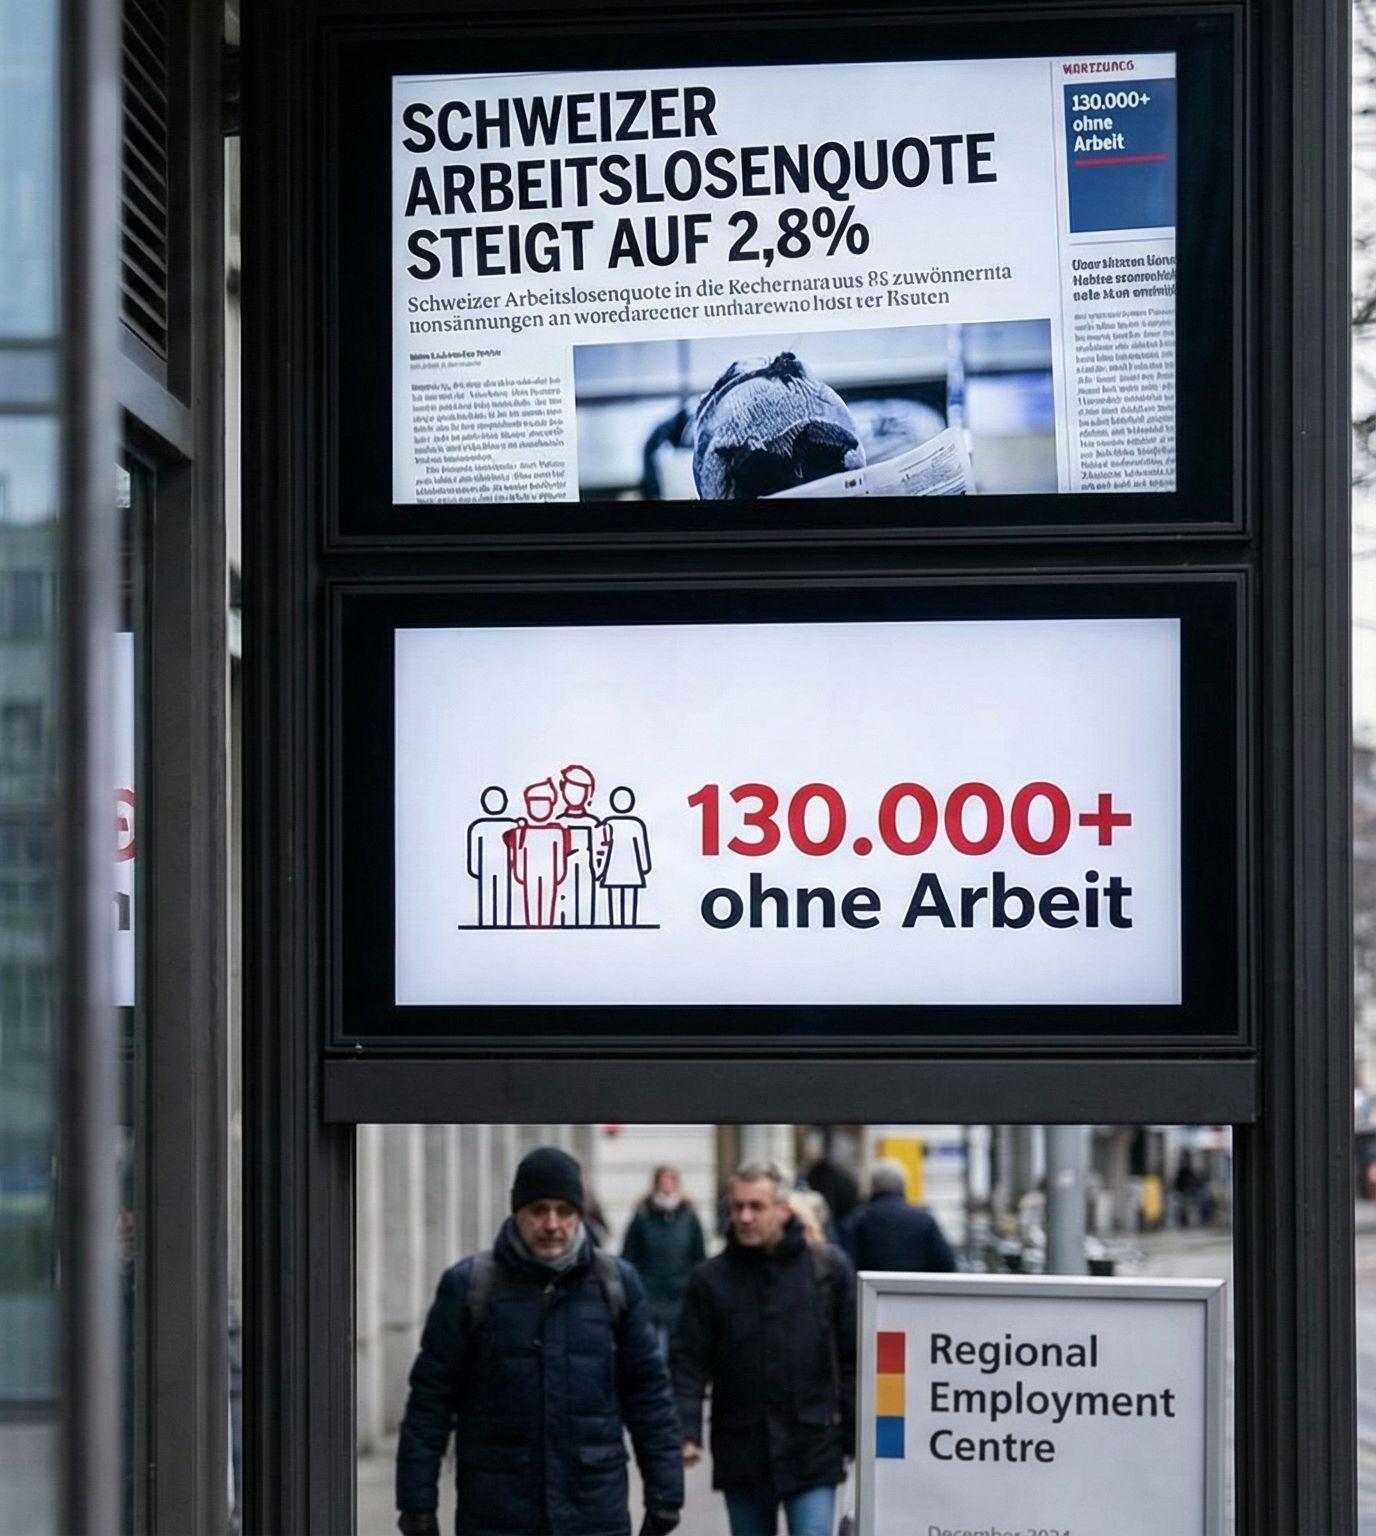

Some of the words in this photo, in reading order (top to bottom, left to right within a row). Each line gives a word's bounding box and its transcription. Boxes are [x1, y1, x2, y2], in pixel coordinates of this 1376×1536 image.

[402, 86, 719, 153] SCHWEIZER
[1071, 90, 1151, 112] 130.000+
[1072, 115, 1113, 132] ohne
[1073, 133, 1126, 152] Arbeit
[404, 132, 998, 217] ARBEITSLOSENQUOTE
[406, 219, 594, 281] STEIGT
[607, 211, 714, 271] AUF
[728, 205, 871, 267] 2,8%
[407, 293, 502, 313] Schweizer
[504, 285, 672, 308] Arbeitslosenquote
[675, 280, 692, 298] in
[695, 279, 724, 297] die
[548, 312, 571, 326] an
[687, 782, 1132, 856] 130.000+
[698, 872, 882, 930] ohne
[900, 870, 1135, 930] Arbeit
[929, 1333, 1099, 1373] Regional
[930, 1381, 1176, 1423] Employment
[929, 1429, 1055, 1462] Centre
